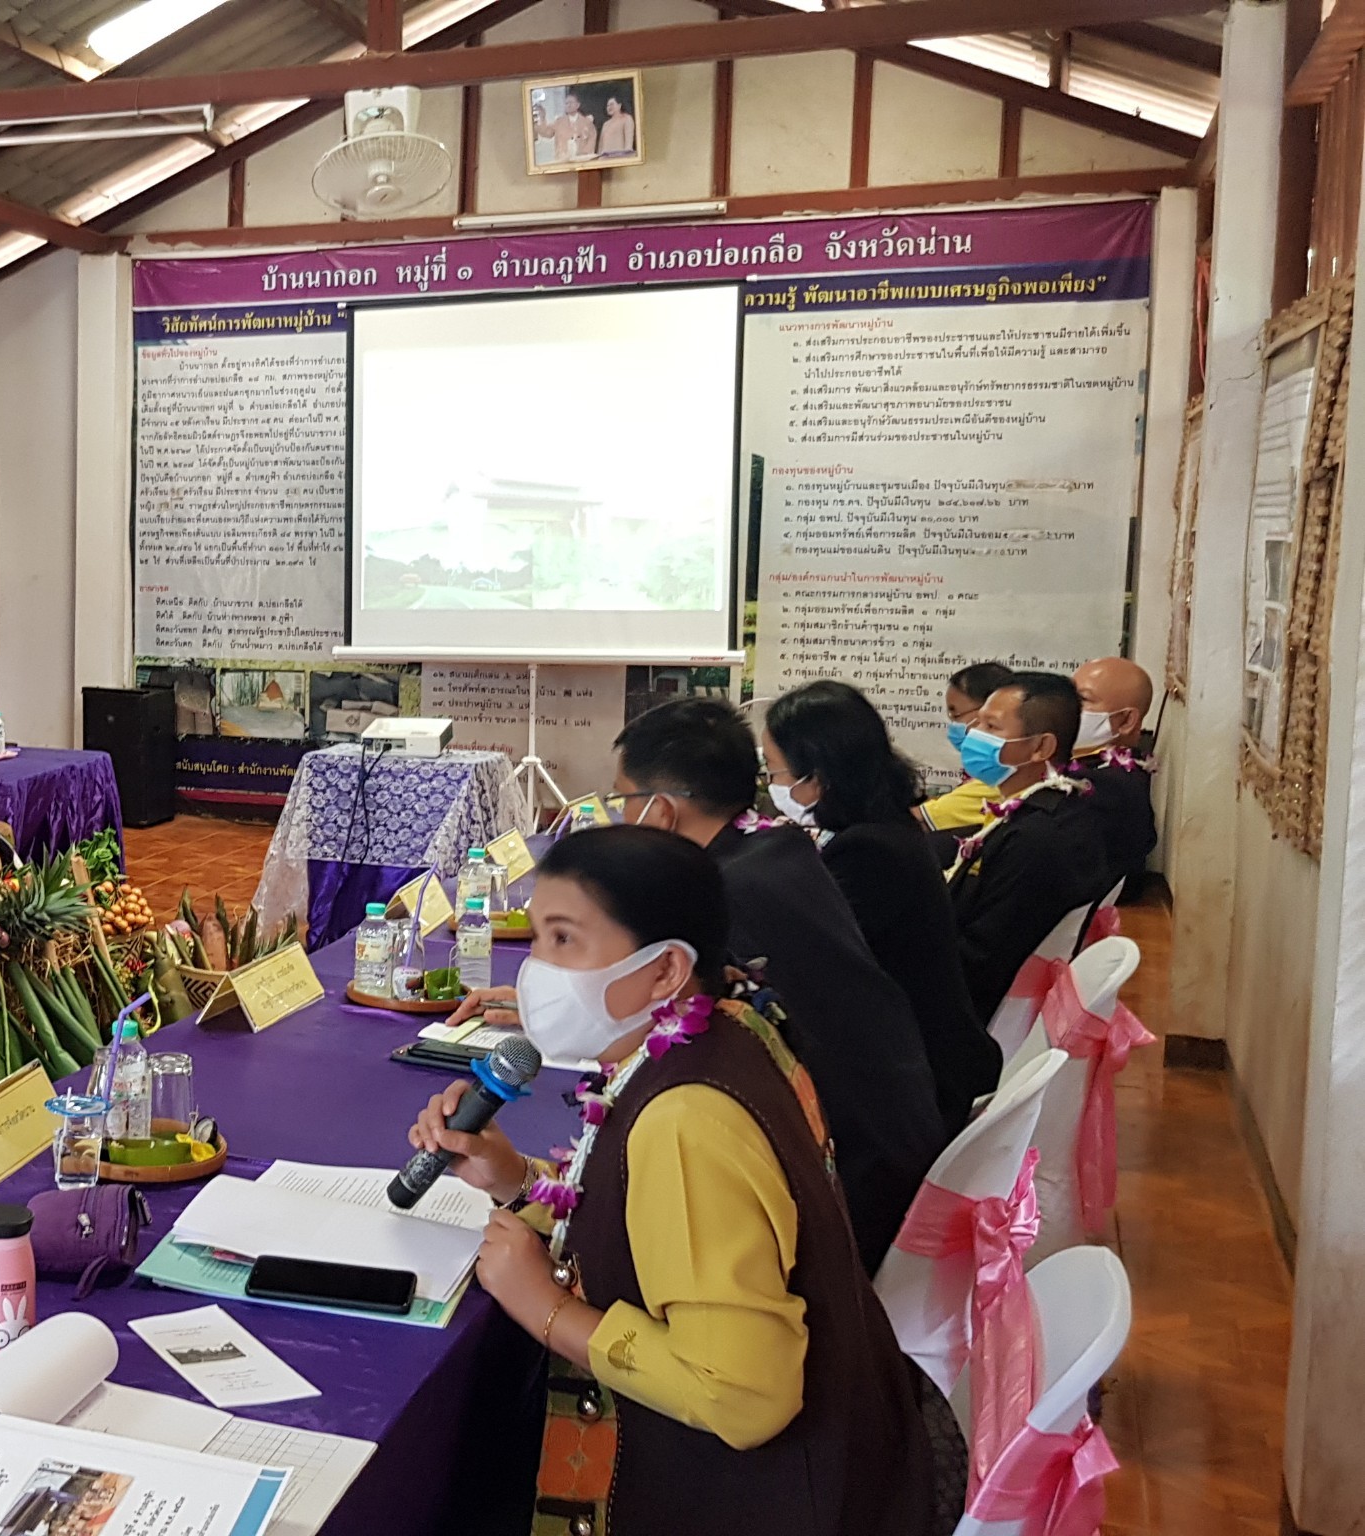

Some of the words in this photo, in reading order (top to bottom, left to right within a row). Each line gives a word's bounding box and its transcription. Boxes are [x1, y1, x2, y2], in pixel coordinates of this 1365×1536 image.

[261, 264, 378, 292] บ้านนากอก
[396, 247, 447, 291] หมู่ที่
[457, 264, 474, 281] ๑
[492, 244, 608, 284] ตำบลภูฟ้า
[628, 234, 804, 272] อำเภอบ่อเกลือ
[824, 226, 973, 262] จังหวัดน่าน
[744, 285, 798, 312] ความรู้
[162, 308, 332, 334] วิสัยทัศน์การพัฒนาหมู่บ้าน
[779, 318, 894, 332] แนวทางการพัฒนาหมู่บ้าน
[804, 366, 903, 379] นำไปประกอบอาชีพได้
[802, 384, 851, 395] ส่งเสริมการ
[771, 464, 854, 478] กองทุนของหมู่บ้าน
[797, 480, 930, 494] กองทุนหมู่บ้านและชุมชนเมือง
[1073, 481, 1094, 490] บาท
[797, 499, 829, 509] กองทุน
[1008, 499, 1029, 507] บาท
[796, 512, 816, 525] กลุ่ม
[959, 514, 979, 523] บาท
[795, 526, 917, 541] กลุ่มออมทรัพย์เพื่อการผลิต
[1054, 531, 1075, 539] บาท
[795, 545, 891, 557] กองทุนแม่ของแผ่นดิน
[1007, 547, 1028, 556] บาท
[795, 603, 915, 617] กลุ่มออมทรัพย์เพื่อการผลิต
[935, 606, 956, 618] กลุ่ม
[913, 622, 933, 634] กลุ่ม
[912, 638, 932, 650] กลุ่ม
[792, 651, 837, 664] กลุ่มอาชีพ
[850, 653, 870, 665] กลุ่ม
[873, 651, 898, 664] ได้แก่
